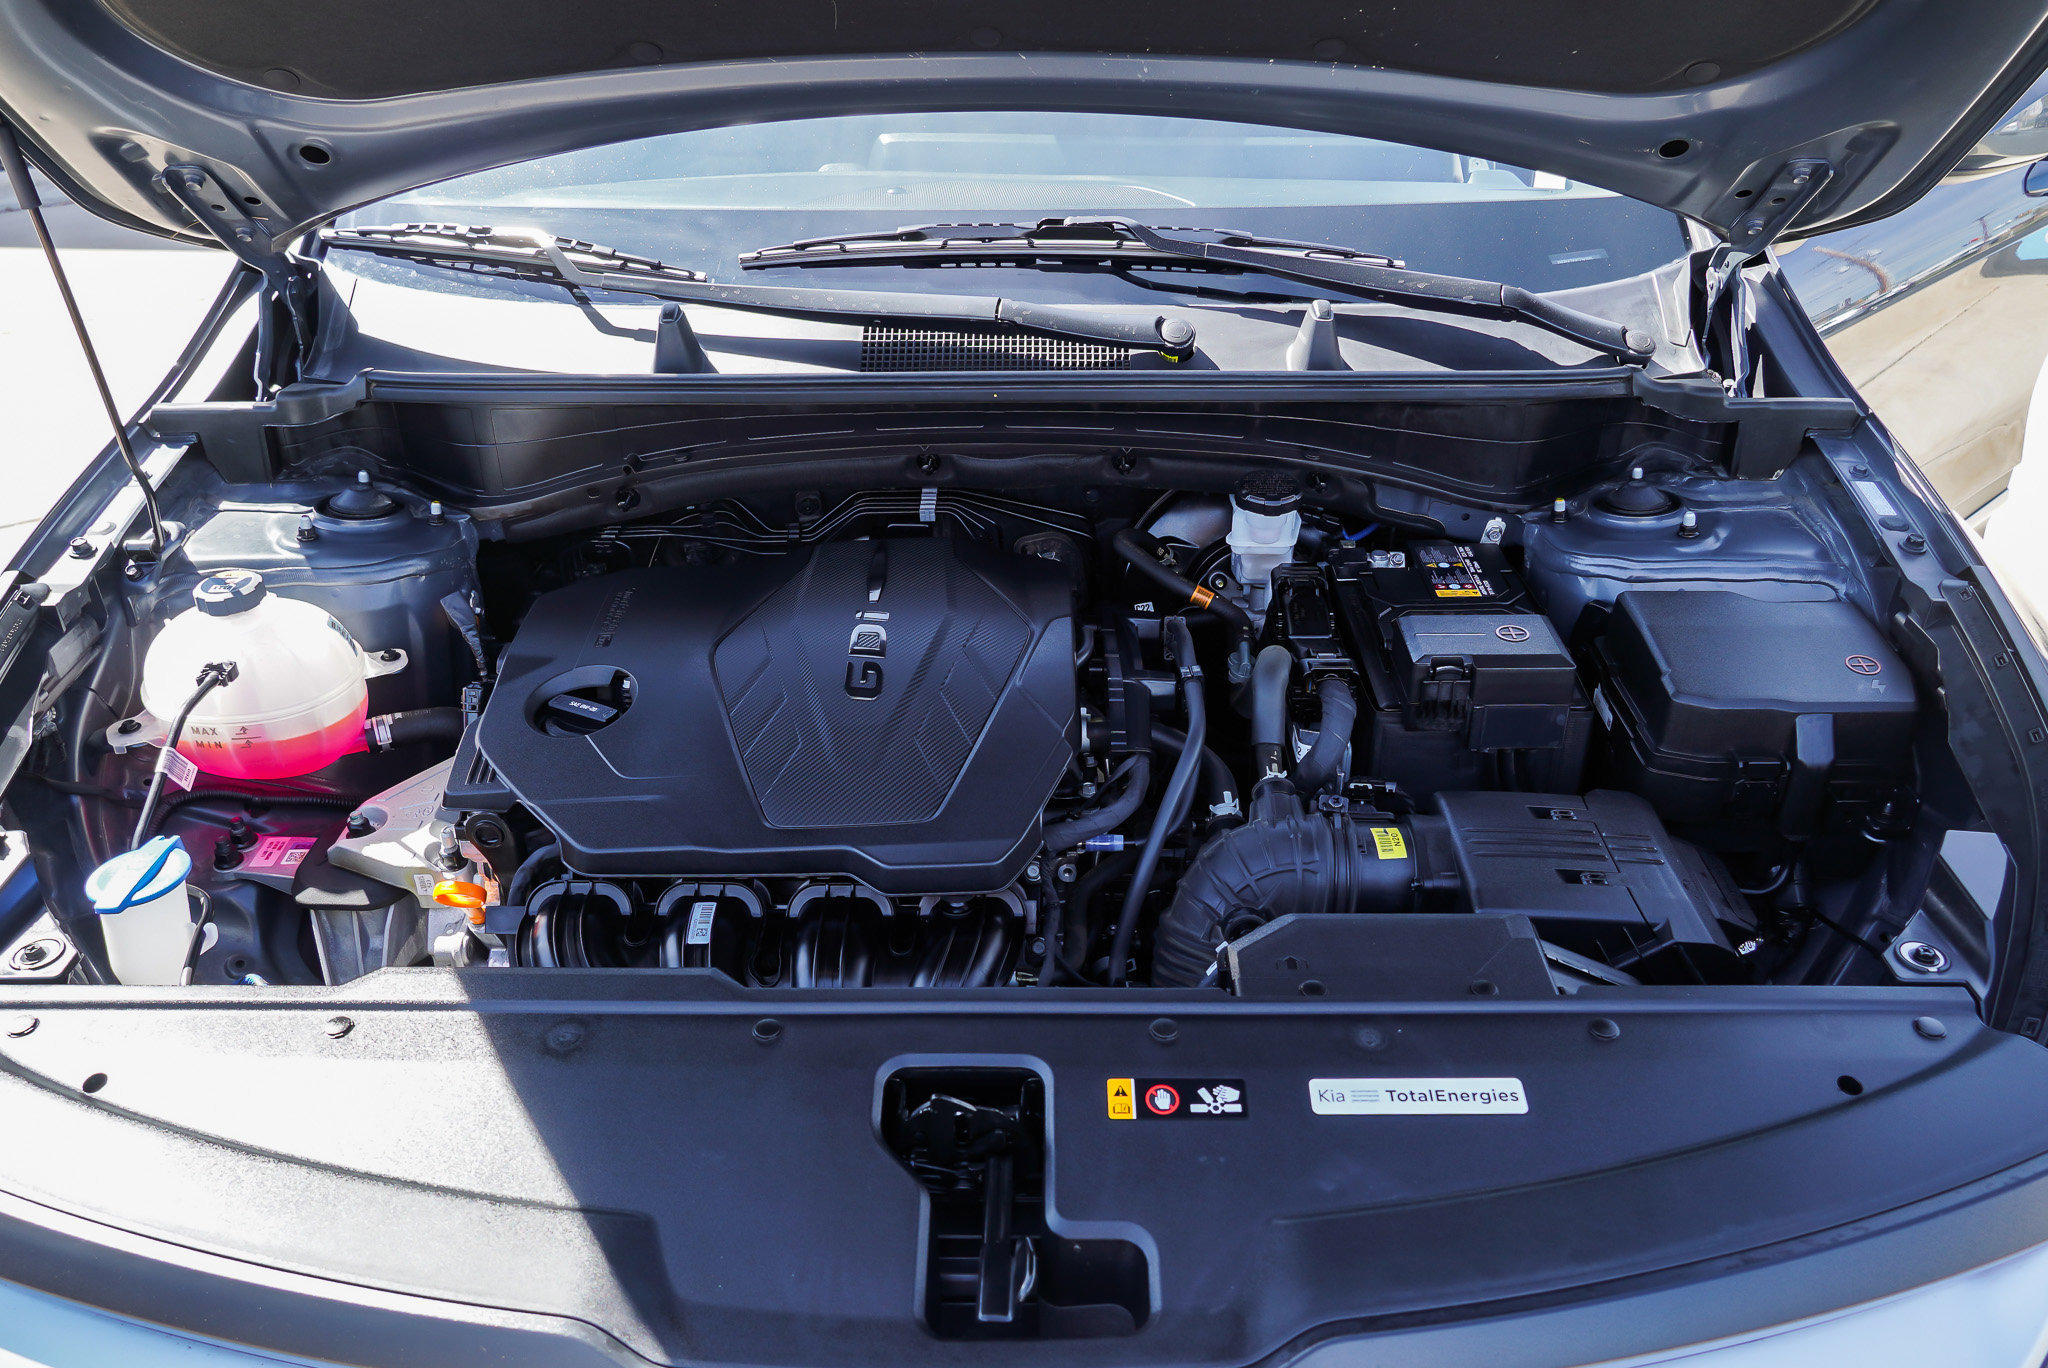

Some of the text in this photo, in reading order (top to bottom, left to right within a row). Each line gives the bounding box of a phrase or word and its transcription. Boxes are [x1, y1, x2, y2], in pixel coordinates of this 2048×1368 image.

[191, 726, 218, 735] MAX
[195, 740, 223, 748] MIN
[1390, 832, 1402, 847] N20
[1318, 1089, 1519, 1105] Kia TotalEnergies
